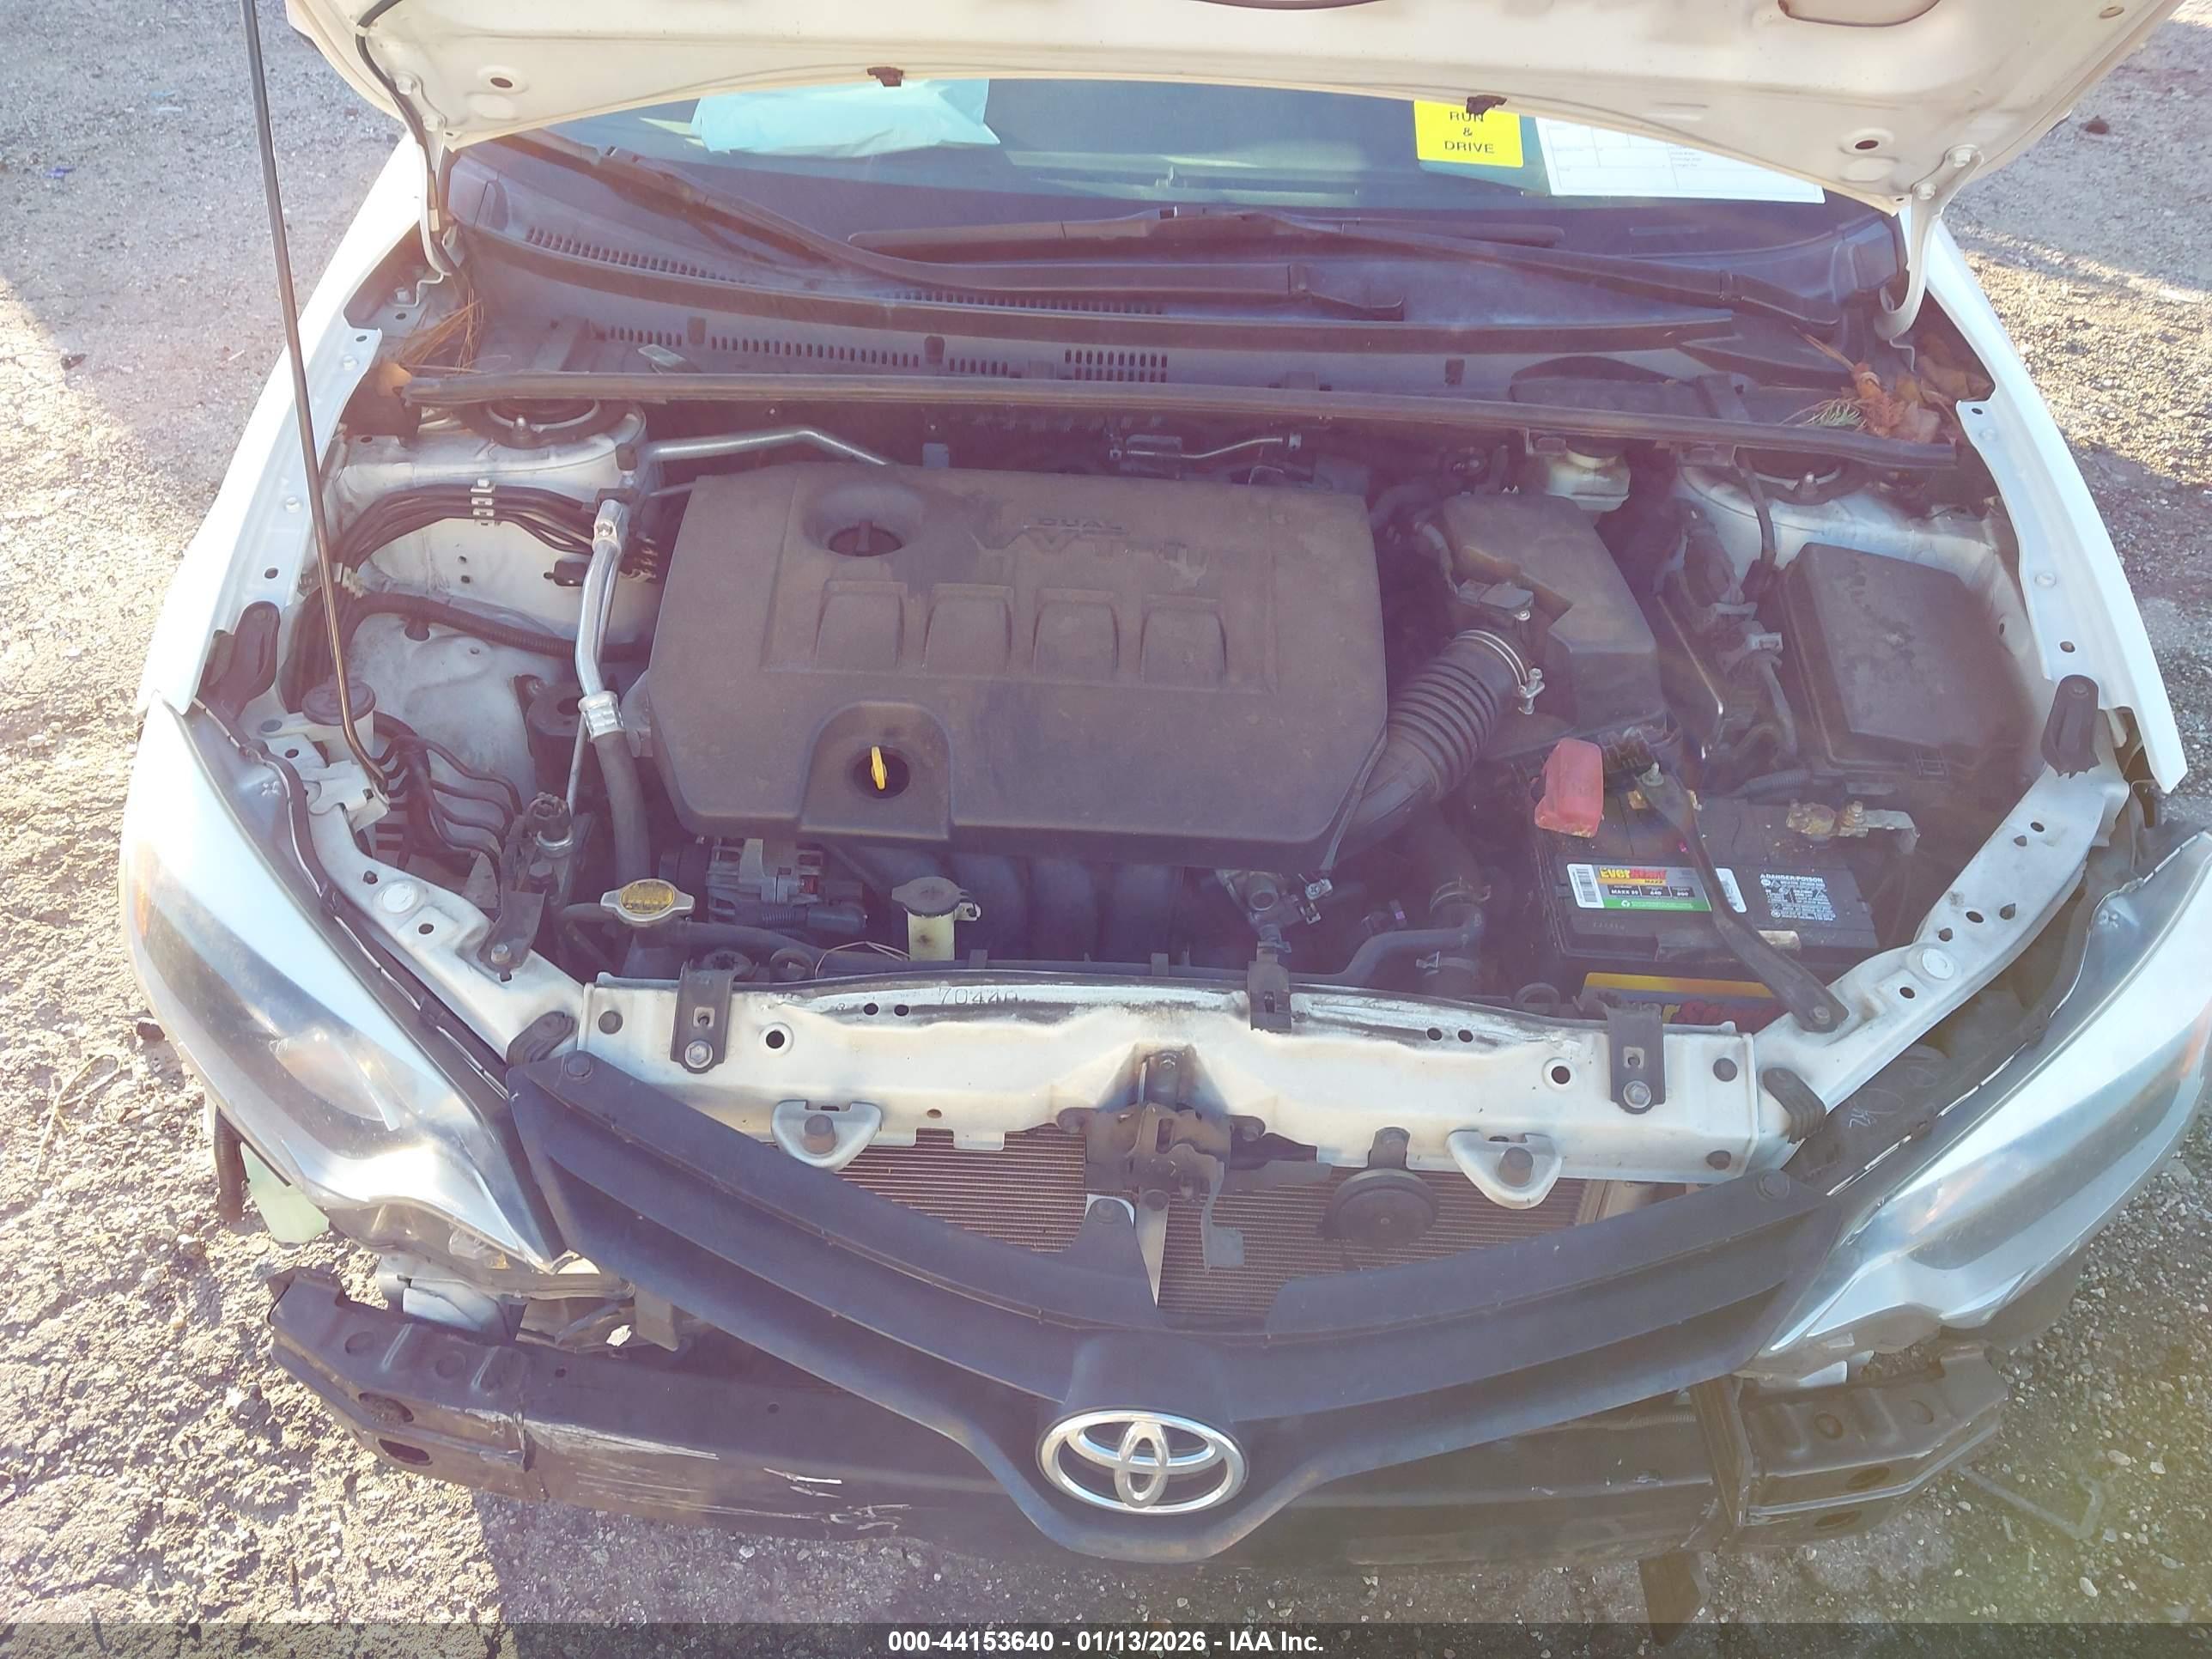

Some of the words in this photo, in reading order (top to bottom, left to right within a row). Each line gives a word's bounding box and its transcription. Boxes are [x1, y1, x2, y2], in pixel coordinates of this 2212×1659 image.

[1449, 112, 1484, 122] RUN
[1463, 127, 1473, 136] &
[1444, 141, 1494, 153] DRIVE
